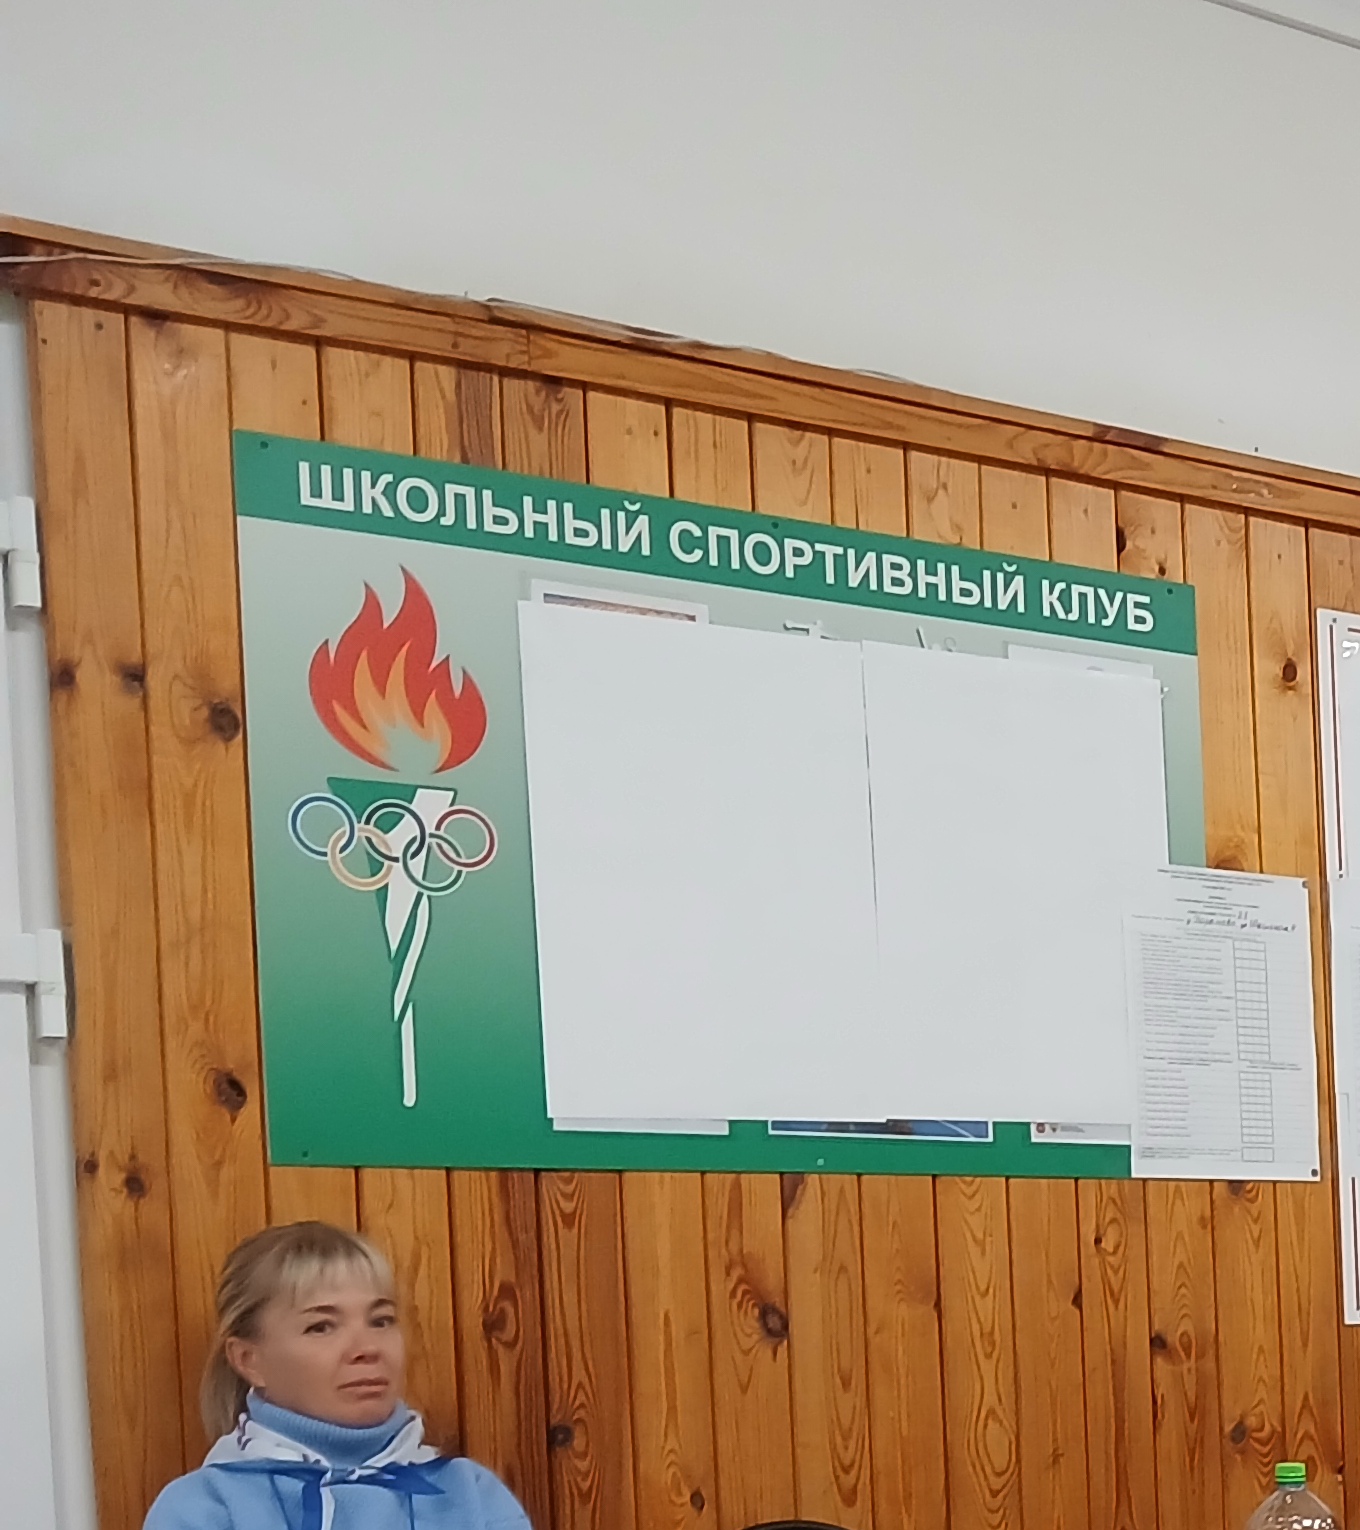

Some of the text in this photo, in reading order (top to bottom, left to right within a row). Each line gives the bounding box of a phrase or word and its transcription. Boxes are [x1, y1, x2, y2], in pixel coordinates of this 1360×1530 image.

[298, 460, 1155, 632] ШКОЛЬНЫЙ СПОРТИВНЫЙ КЛУБ
